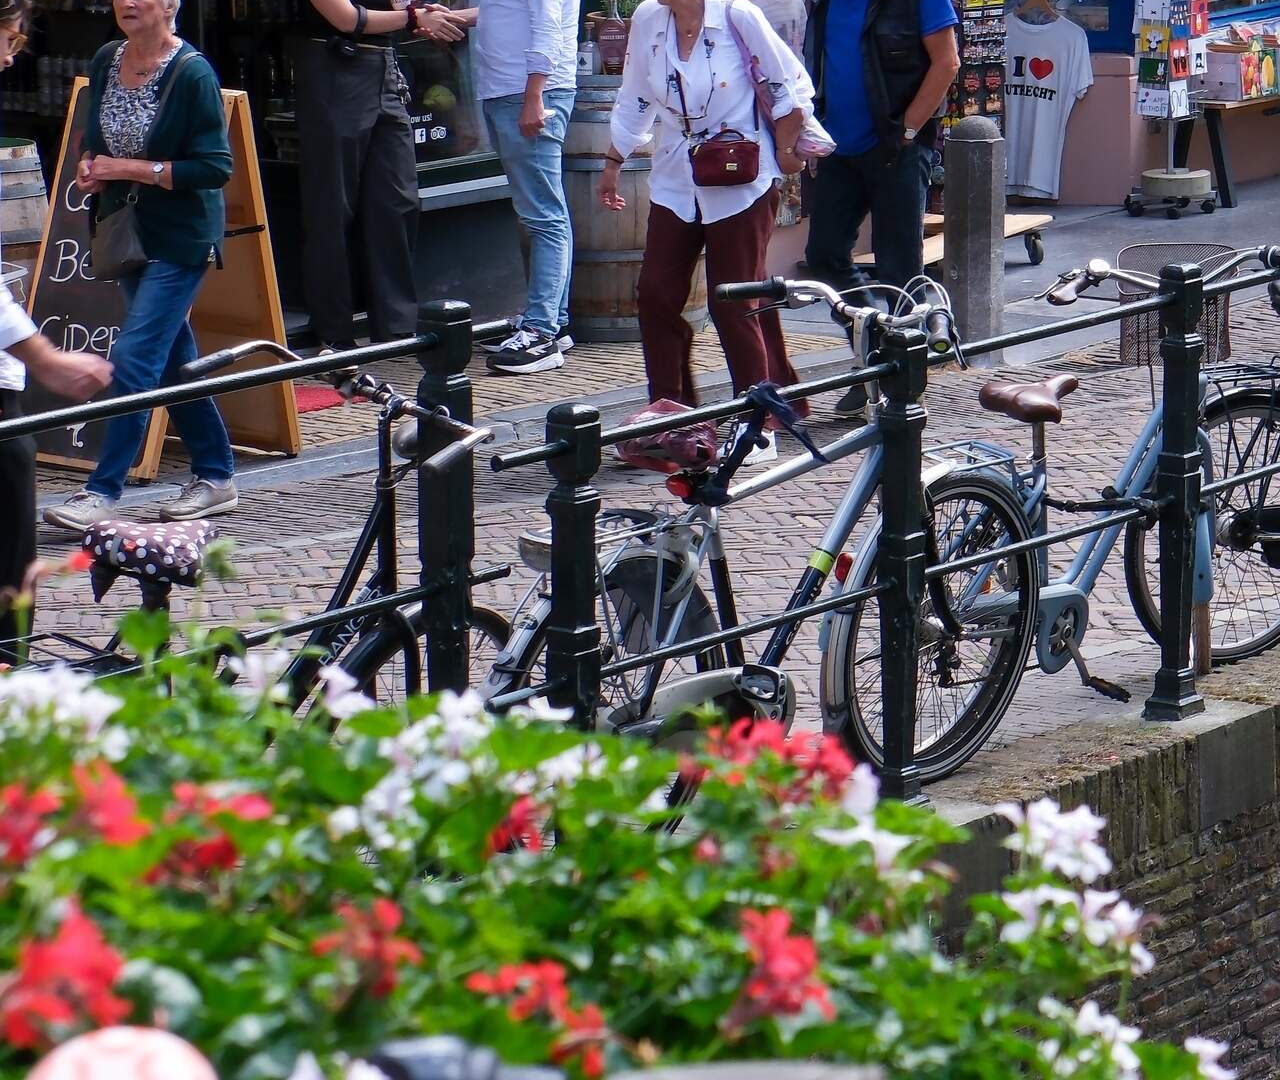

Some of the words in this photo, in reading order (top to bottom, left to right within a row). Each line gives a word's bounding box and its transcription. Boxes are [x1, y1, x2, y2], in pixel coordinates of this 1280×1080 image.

[1013, 55, 1026, 78] I
[1005, 82, 1057, 102] UTRECHT
[422, 112, 433, 123] us!
